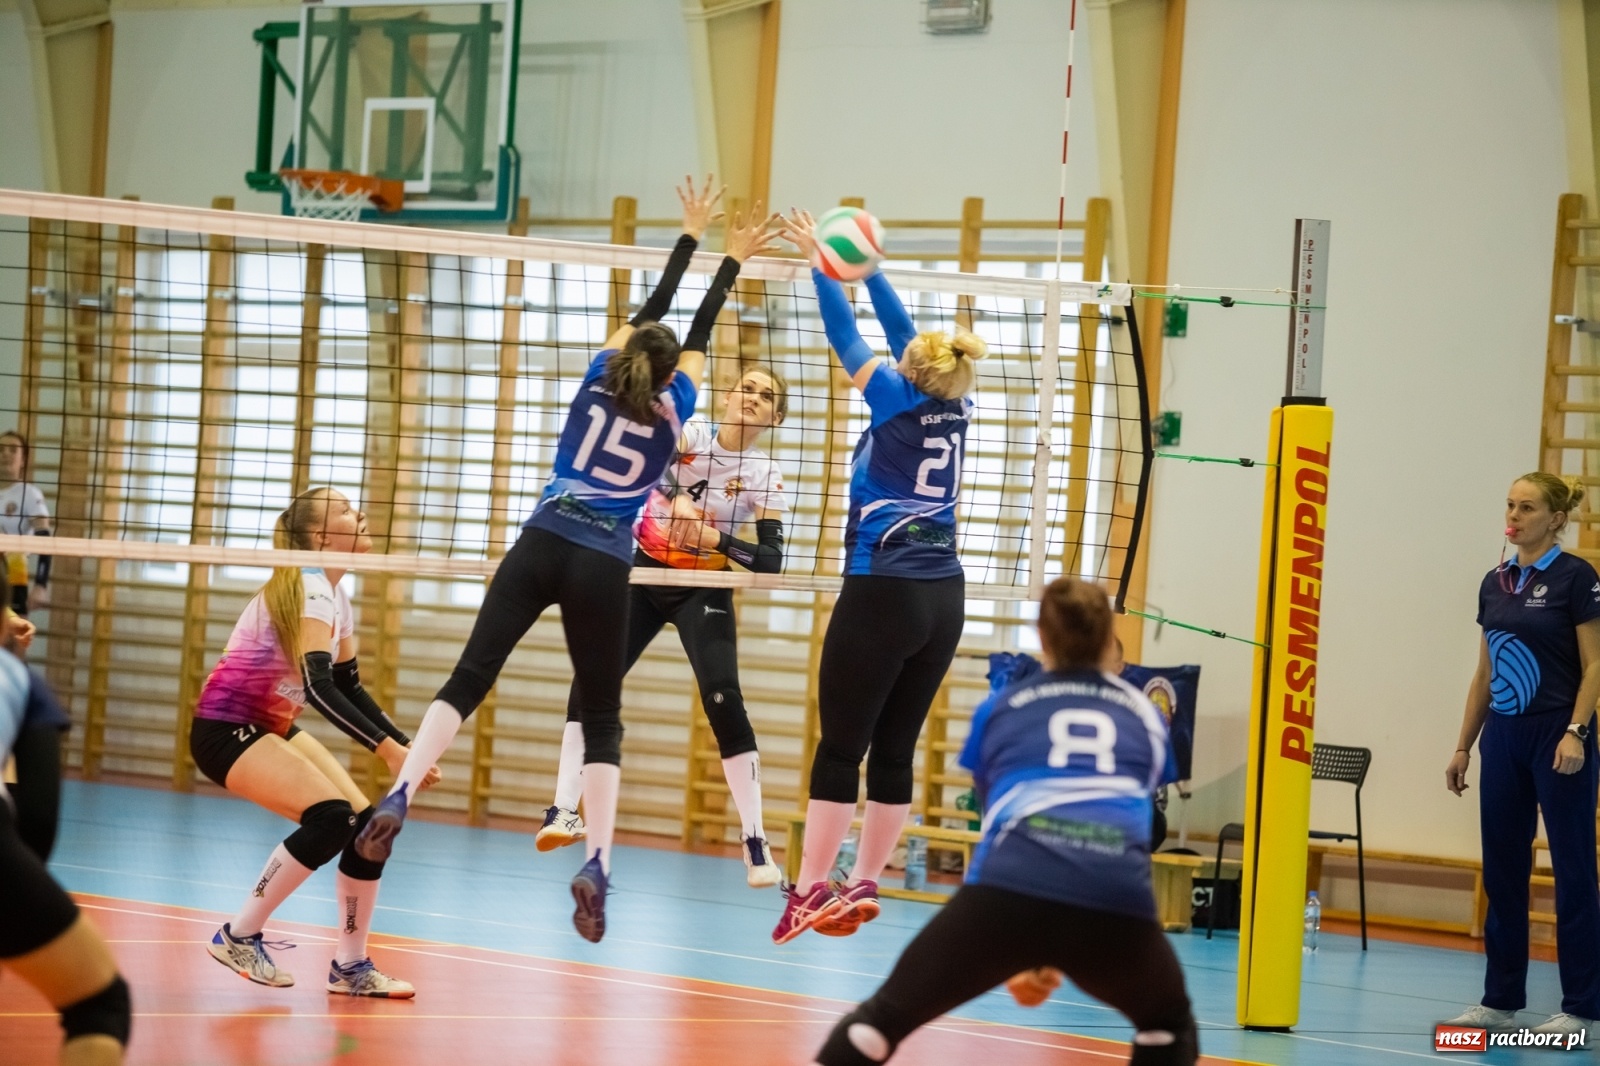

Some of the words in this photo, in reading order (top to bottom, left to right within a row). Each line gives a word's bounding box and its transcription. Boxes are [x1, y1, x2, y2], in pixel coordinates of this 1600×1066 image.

[1301, 239, 1314, 369] PESMENPOL
[571, 403, 655, 488] 15
[913, 432, 962, 499] 21
[686, 478, 709, 503] 4
[1280, 440, 1331, 766] PESMENPOL
